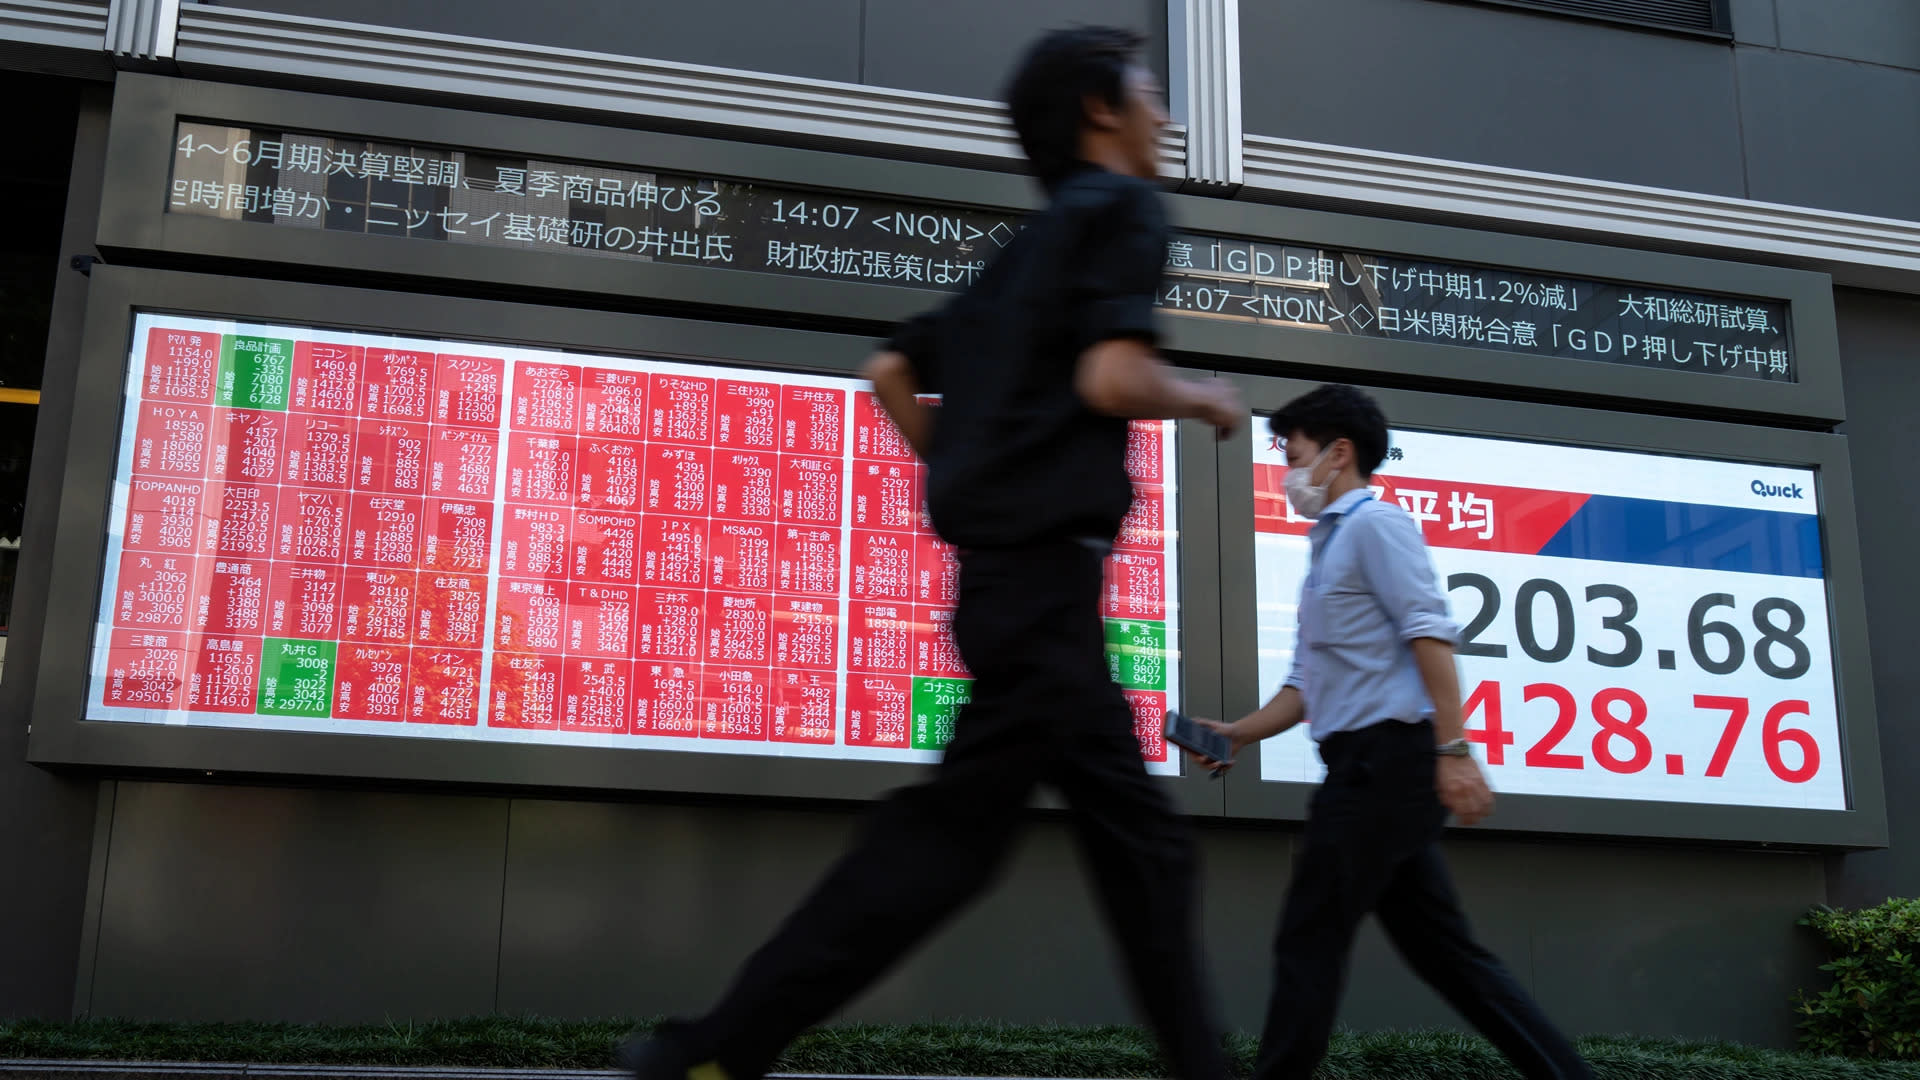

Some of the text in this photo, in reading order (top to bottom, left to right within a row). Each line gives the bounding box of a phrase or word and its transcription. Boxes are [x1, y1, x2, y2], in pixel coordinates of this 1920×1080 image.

[772, 199, 859, 229] 14:07
[168, 345, 213, 360] 1154.0
[253, 353, 286, 365] 6767
[173, 356, 212, 369] +99.0
[314, 359, 357, 372] 1460.0
[254, 363, 284, 376] -335
[319, 369, 356, 382] +83.5
[385, 365, 428, 378] 1769.5
[389, 375, 426, 388] +94.5
[459, 371, 497, 384] 12285
[464, 381, 496, 394] +245
[532, 377, 575, 392] 2272.5
[600, 384, 642, 398] 2096.0
[530, 388, 574, 401] +108.0
[606, 394, 641, 407] +96.0
[669, 390, 709, 403] 1393.0
[673, 400, 708, 413] +89.5
[745, 396, 775, 409] 3990
[810, 402, 839, 415] 3823
[750, 407, 773, 418] +91
[808, 412, 839, 424] +186
[164, 419, 205, 433] 18550
[245, 425, 278, 438] 4157
[307, 431, 351, 444] 1379.5
[397, 437, 421, 450] 902
[460, 443, 492, 455] 4777
[529, 449, 570, 463] 1417.0
[607, 455, 637, 468] 4161
[675, 461, 704, 473] 4391
[743, 466, 772, 479] 3390
[798, 471, 837, 484] 1059.0
[881, 477, 910, 489] 5297
[133, 479, 201, 495] TOPPANHD
[880, 487, 909, 499] +113
[1751, 479, 1803, 499] Quick
[162, 494, 196, 507] 4018
[224, 498, 270, 513] 2253.5
[299, 504, 343, 518] 1076.5
[376, 510, 415, 523] 12910
[455, 515, 486, 528] 7908
[578, 513, 636, 528] SOMPOHD
[529, 521, 565, 535] 983.3
[602, 527, 634, 540] 4426
[722, 524, 763, 536] MS&AD
[661, 531, 702, 544] 1495.0
[739, 537, 769, 549] 3199
[795, 541, 835, 554] 1180.5
[868, 546, 909, 559] 2950.0
[874, 556, 908, 569] +39.5
[153, 570, 187, 583] 3062
[1128, 565, 1159, 577] 576.4
[229, 575, 262, 587] 3464
[303, 580, 336, 593] 3147
[1127, 575, 1159, 587] +25.4
[368, 584, 409, 597] 28110
[449, 589, 480, 603] 3875
[528, 595, 560, 608] 6093
[599, 600, 629, 613] 3572
[657, 604, 699, 617] 1339.0
[724, 608, 766, 621] 2830.0
[791, 613, 833, 624] 2515.5
[867, 618, 907, 630] 1853.0
[872, 628, 907, 640] +43.5
[1132, 635, 1160, 647] 9451
[144, 648, 178, 661] 3026
[208, 652, 254, 665] 1165.5
[128, 658, 177, 671] +112.0
[213, 663, 253, 676] +26.0
[295, 657, 329, 670] 3008
[370, 661, 402, 674] 3978
[442, 665, 474, 678] 4721
[524, 671, 555, 683] 5443
[375, 672, 401, 685] +66
[582, 674, 625, 687] 2543.5
[653, 678, 695, 691] 1694.5
[519, 681, 554, 693] +118
[588, 685, 625, 697] +40.0
[722, 682, 763, 695] 1614.0
[801, 686, 830, 699] 3482
[876, 690, 905, 703] 5376
[881, 701, 905, 713] +93
